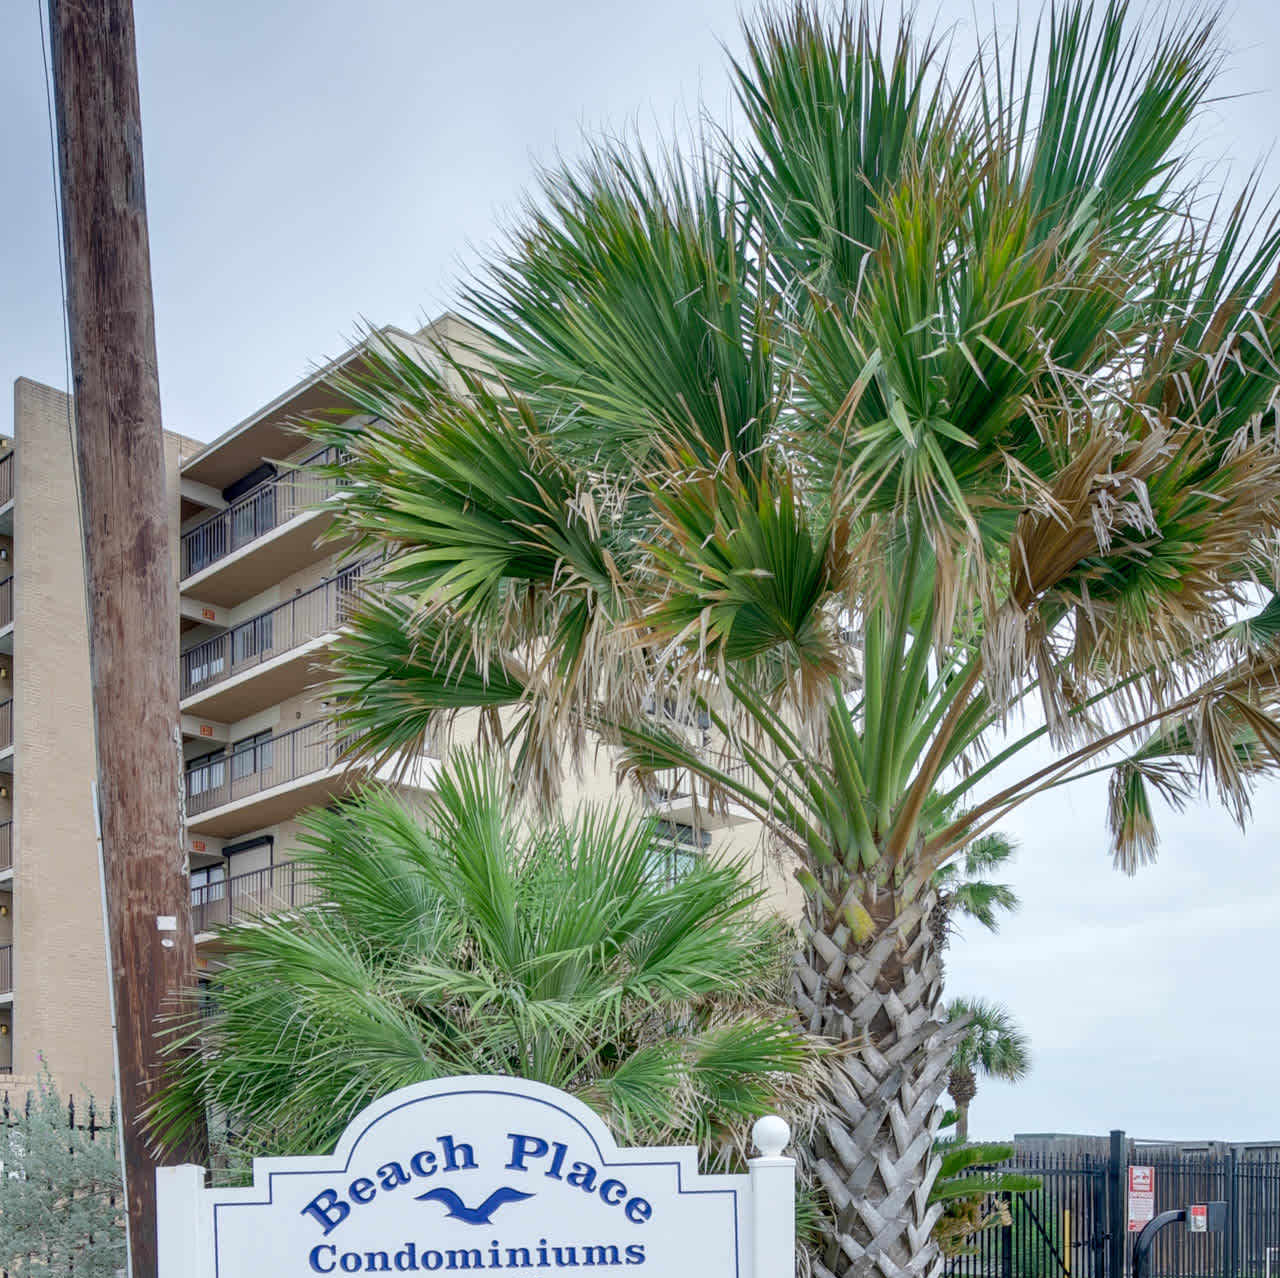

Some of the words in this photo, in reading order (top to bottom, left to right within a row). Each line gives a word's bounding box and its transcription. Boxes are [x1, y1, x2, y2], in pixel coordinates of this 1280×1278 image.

[300, 1134, 480, 1237] Beach
[504, 1132, 654, 1225] Place
[308, 1237, 647, 1274] Condominiums
